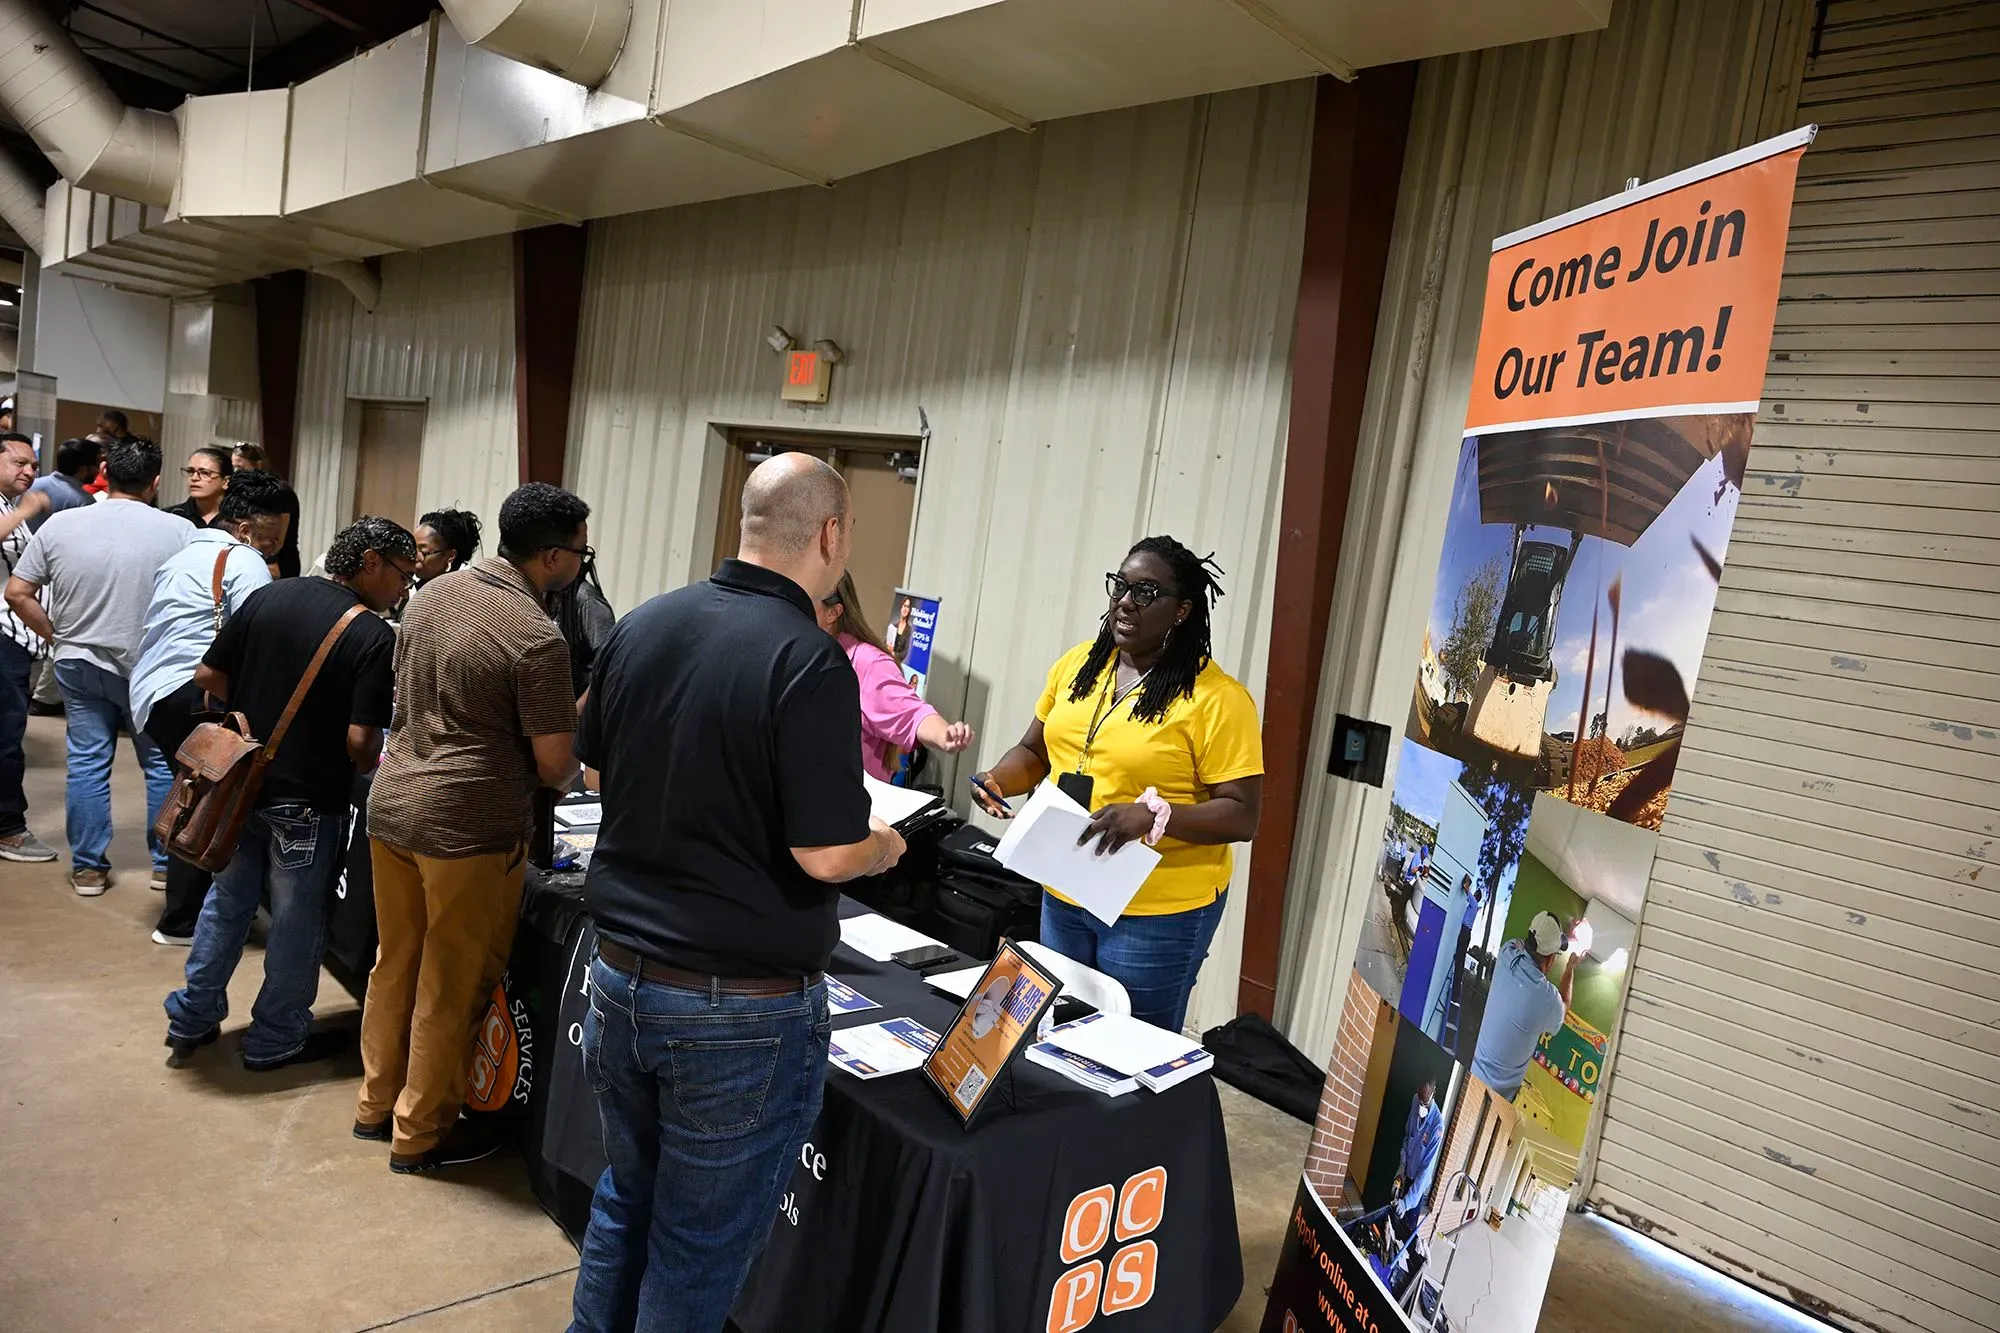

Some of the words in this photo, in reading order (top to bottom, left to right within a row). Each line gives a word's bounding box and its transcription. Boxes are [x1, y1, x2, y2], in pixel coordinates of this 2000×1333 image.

[1507, 246, 1621, 312] Come
[1627, 200, 1746, 283] Join
[1493, 347, 1567, 400] Our
[1576, 305, 1734, 388] Team!
[999, 989, 1035, 1027] HIRING!
[1012, 972, 1029, 994] WE
[1023, 980, 1046, 1011] ARE
[509, 999, 533, 1105] SERVICES
[1062, 1051, 1101, 1072] HIRING
[1294, 1205, 1321, 1260] Apply
[1319, 1251, 1355, 1309] online
[1354, 1301, 1370, 1331] at
